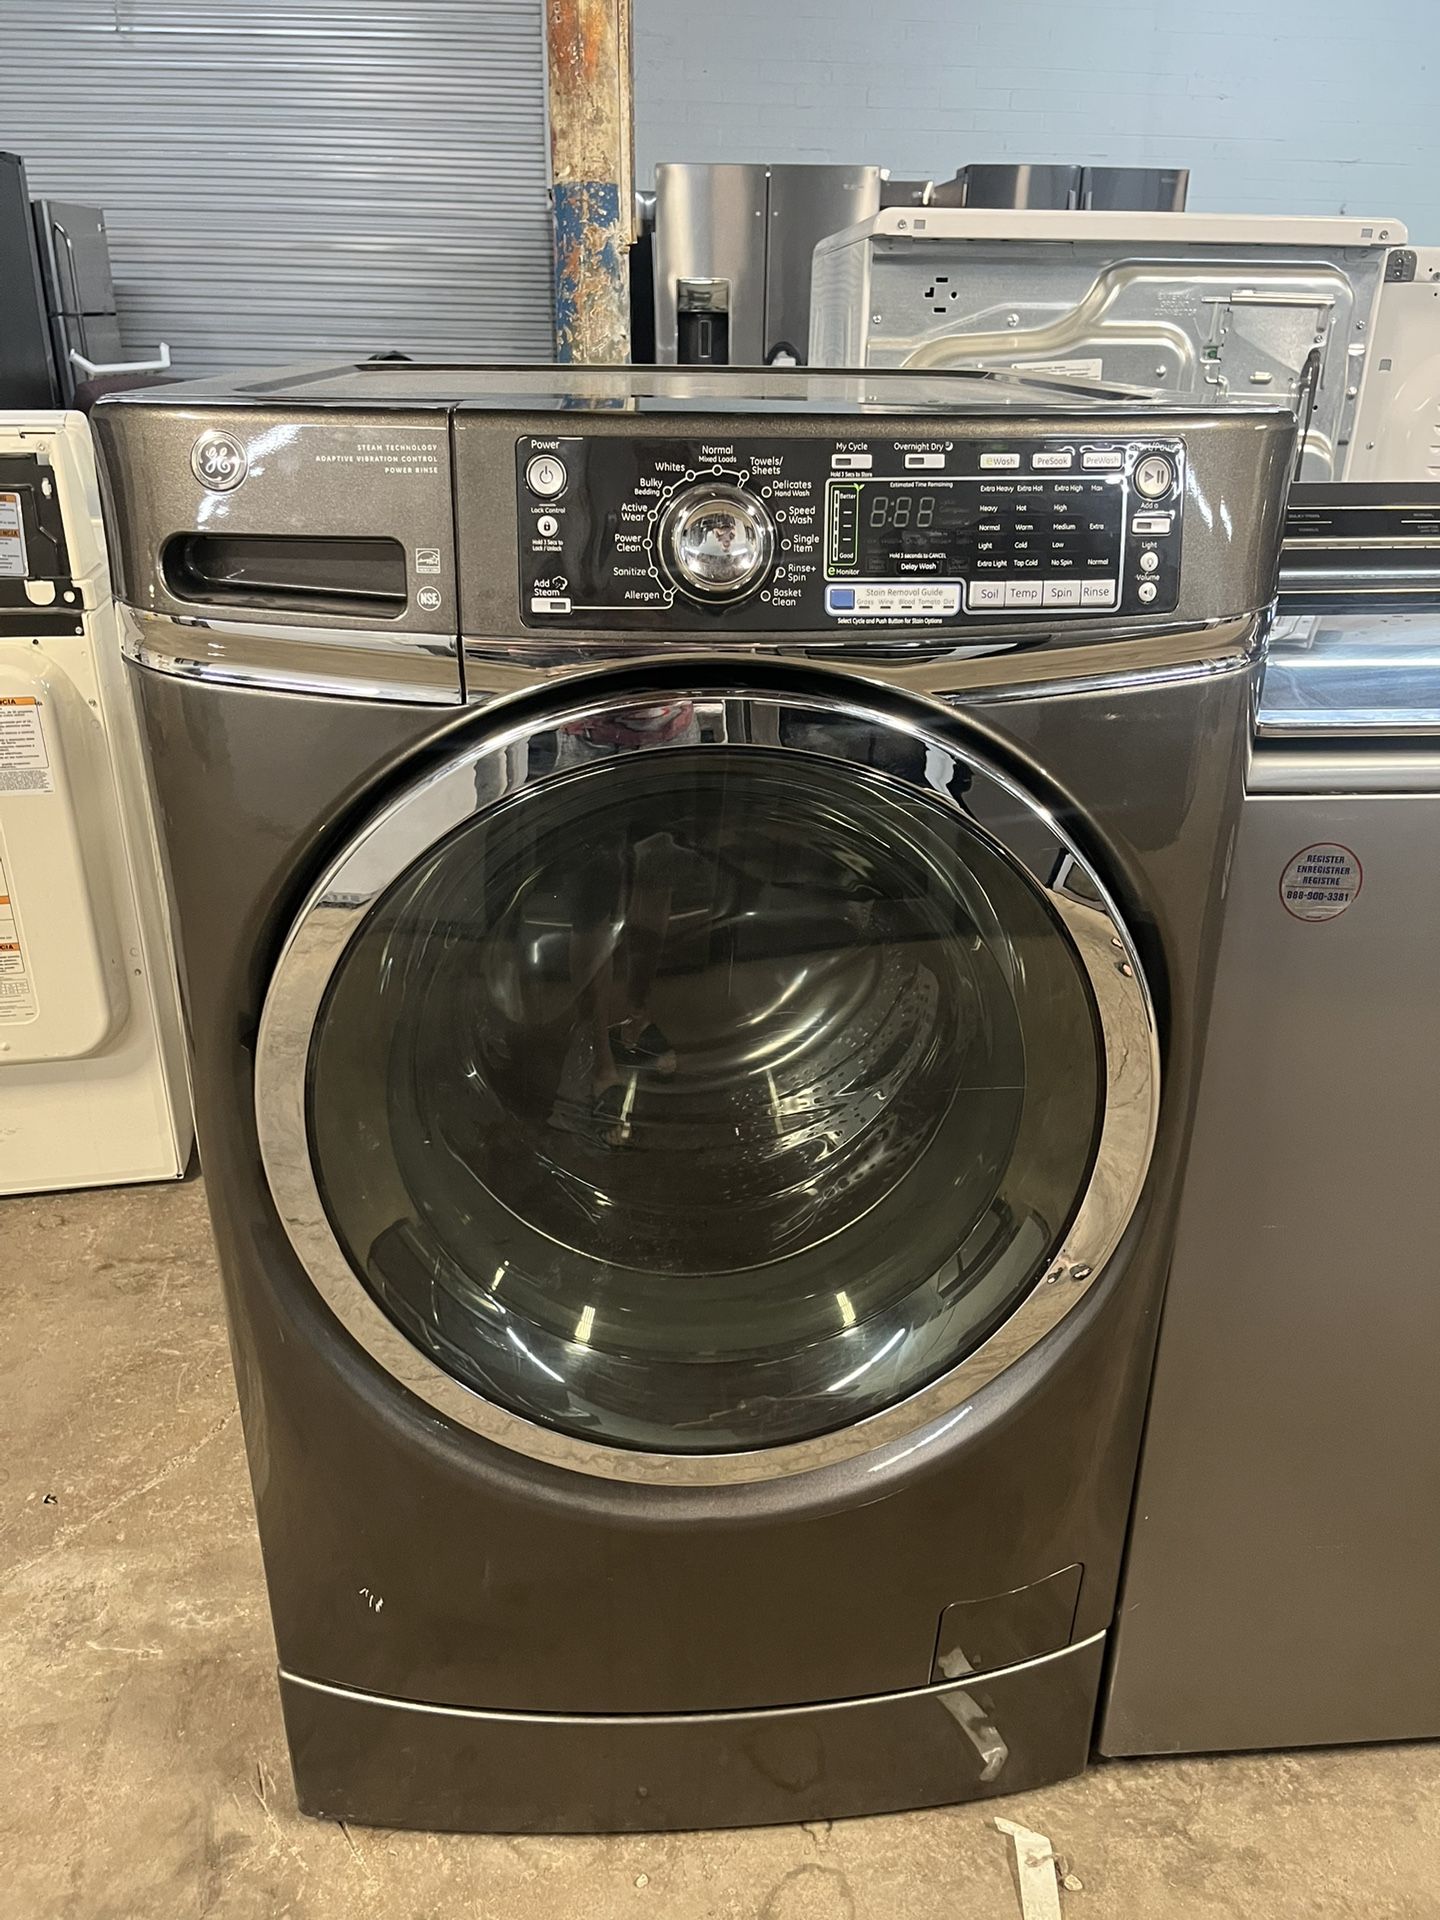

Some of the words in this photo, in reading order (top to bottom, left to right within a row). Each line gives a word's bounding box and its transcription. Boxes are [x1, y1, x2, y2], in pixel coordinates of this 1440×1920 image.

[531, 440, 560, 450] Power
[702, 445, 733, 454] Normal
[836, 442, 847, 452] My
[848, 442, 868, 452] Cycle
[893, 442, 930, 452] Overnight
[930, 442, 943, 453] Dry
[205, 447, 231, 473] GE
[401, 455, 438, 463] CONTROL
[750, 456, 783, 466] Towels/
[1037, 457, 1068, 465] PreSoak
[1086, 456, 1119, 465] PreWash
[655, 463, 686, 472] Whites
[751, 466, 781, 475] Sheets
[640, 478, 663, 488] Bulky
[773, 480, 812, 489] Delicates
[634, 488, 660, 497] Bedding
[774, 489, 791, 497] Hand
[792, 489, 810, 497] Wash
[996, 485, 1014, 494] Heavy
[1054, 484, 1070, 492] Extra
[1070, 484, 1083, 494] High
[621, 503, 648, 512] Active
[789, 506, 816, 516] Speed
[979, 505, 998, 514] Heavy
[1053, 504, 1068, 513] High
[621, 513, 645, 522] Wear
[788, 516, 812, 524] Wash
[614, 534, 641, 543] Power
[794, 534, 820, 544] Single
[616, 544, 641, 553] Clean
[793, 544, 813, 553] Item
[978, 542, 993, 551] Light
[1014, 541, 1028, 549] Cold
[1142, 541, 1158, 549] Light
[993, 560, 1008, 569] Light
[1014, 560, 1025, 568] Tap
[1060, 559, 1073, 568] Spin
[1087, 558, 1109, 566] Normal
[613, 567, 647, 576] Sanitize
[788, 564, 817, 573] Rinse+
[900, 563, 918, 572] Delay
[919, 562, 937, 570] Wash
[788, 573, 807, 583] Spin
[1137, 573, 1160, 581] Volume
[534, 578, 550, 588] Add
[534, 588, 560, 596] Steam
[624, 590, 660, 601] Allergen
[773, 588, 802, 597] Basket
[866, 588, 886, 597] Stain
[887, 588, 920, 597] Removal
[921, 588, 943, 597] Guide
[981, 588, 999, 599] Soil
[1010, 588, 1038, 599] Temp
[1051, 587, 1072, 600] Spin
[1083, 586, 1110, 597] Rinse
[773, 597, 796, 606] Clean
[852, 618, 865, 626] Cycle
[925, 617, 943, 625] Options
[1306, 854, 1345, 864] REGISTER
[1296, 865, 1351, 875] ENREGISTRER
[1302, 876, 1341, 886] REGISTRE
